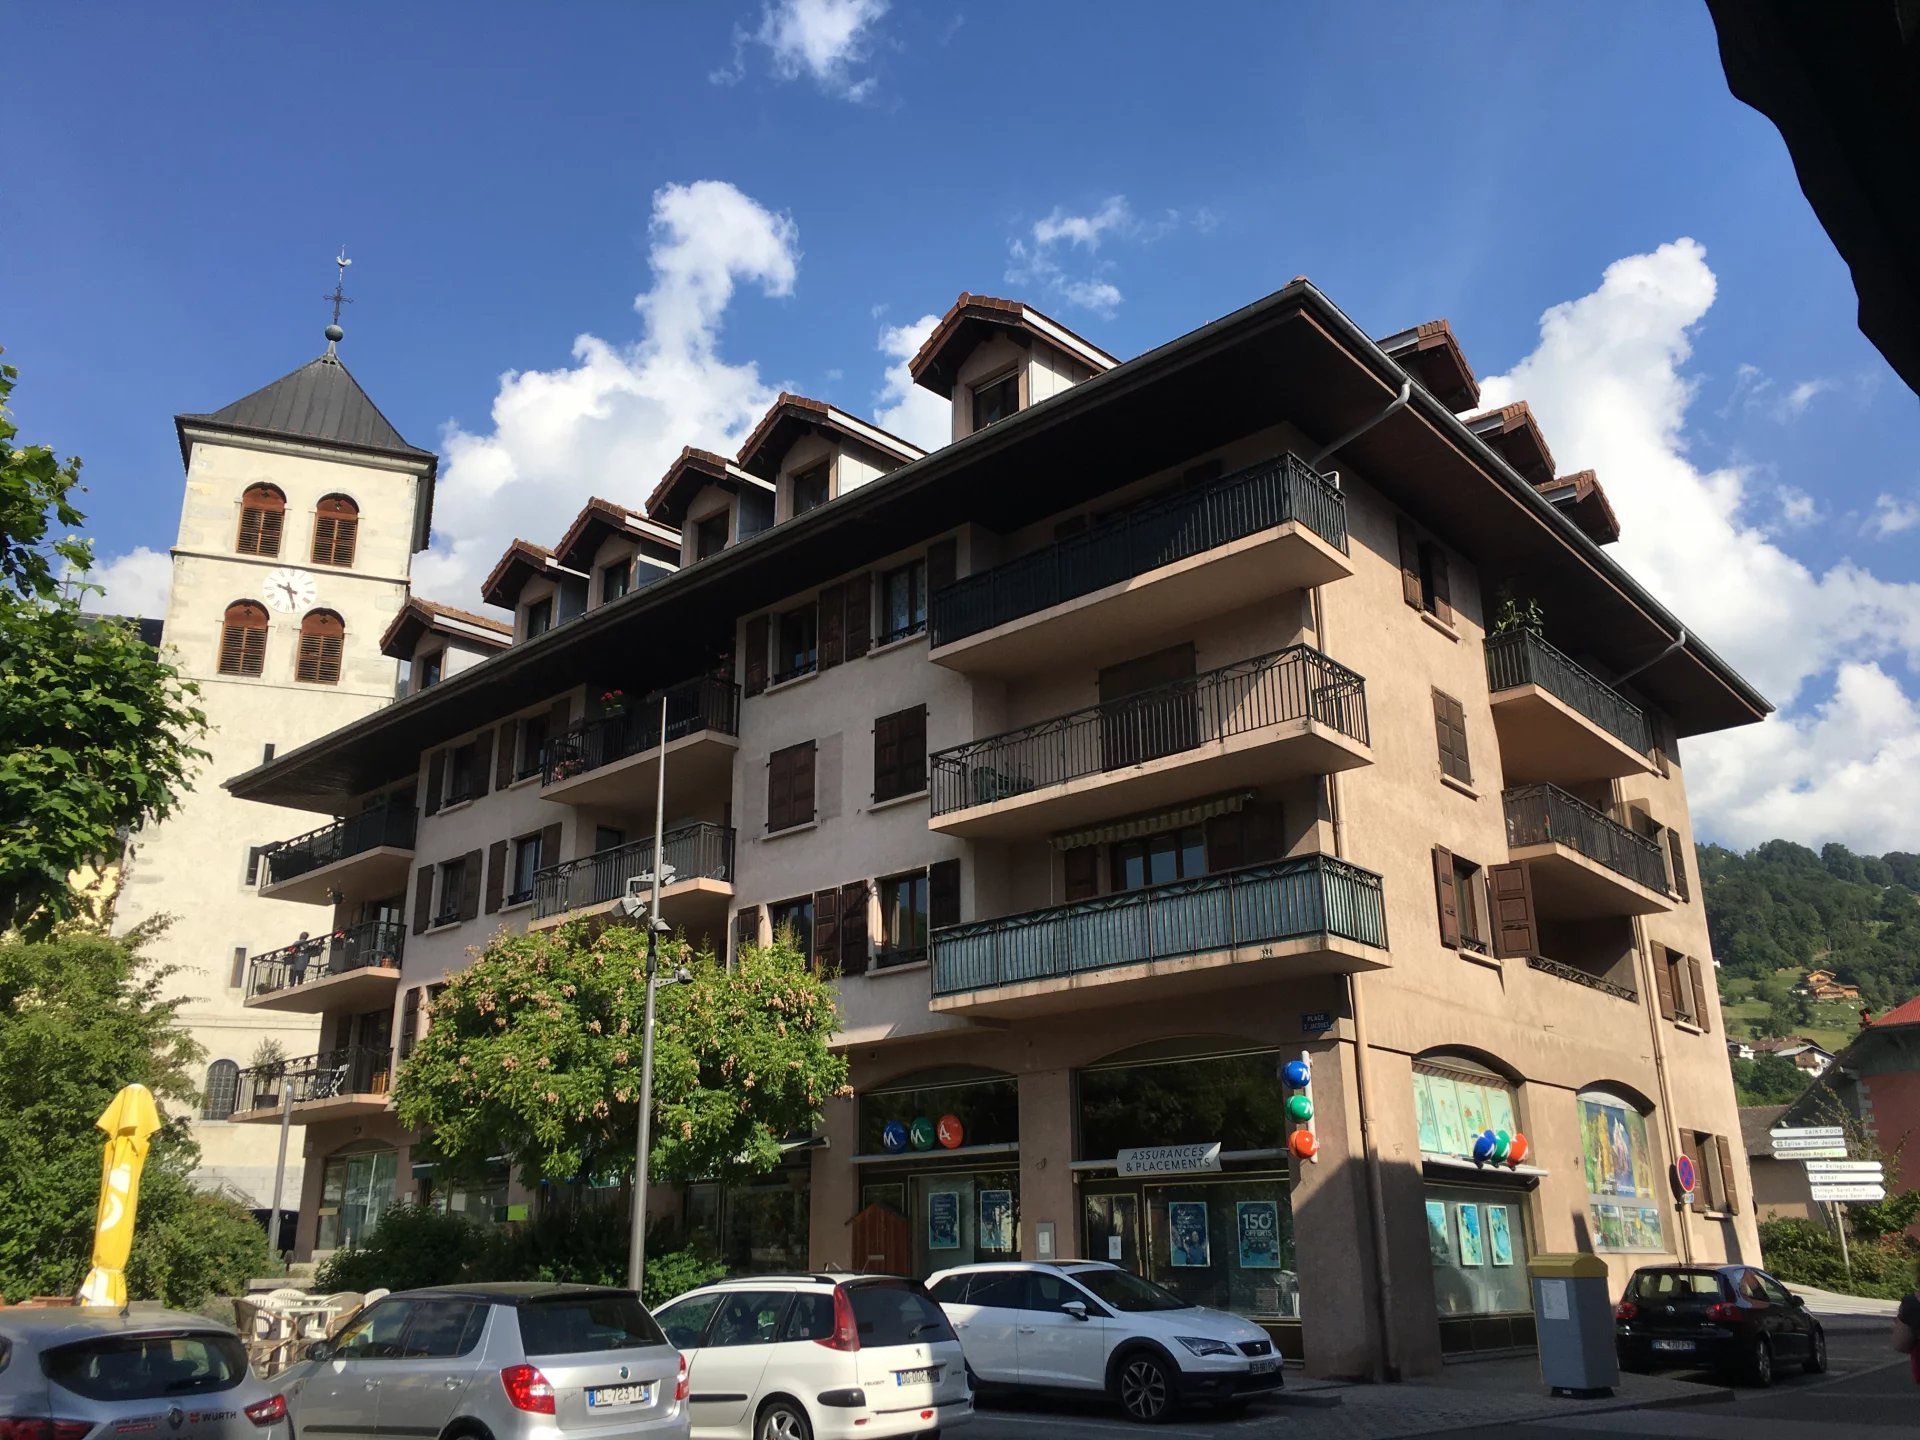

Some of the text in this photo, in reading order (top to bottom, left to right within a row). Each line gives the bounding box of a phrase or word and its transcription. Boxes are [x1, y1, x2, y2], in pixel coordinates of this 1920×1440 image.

[1131, 1146, 1205, 1161] ASSURANCES
[1126, 1157, 1211, 1172] & PLACEMENTS
[1244, 1229, 1273, 1237] OFFERTS
